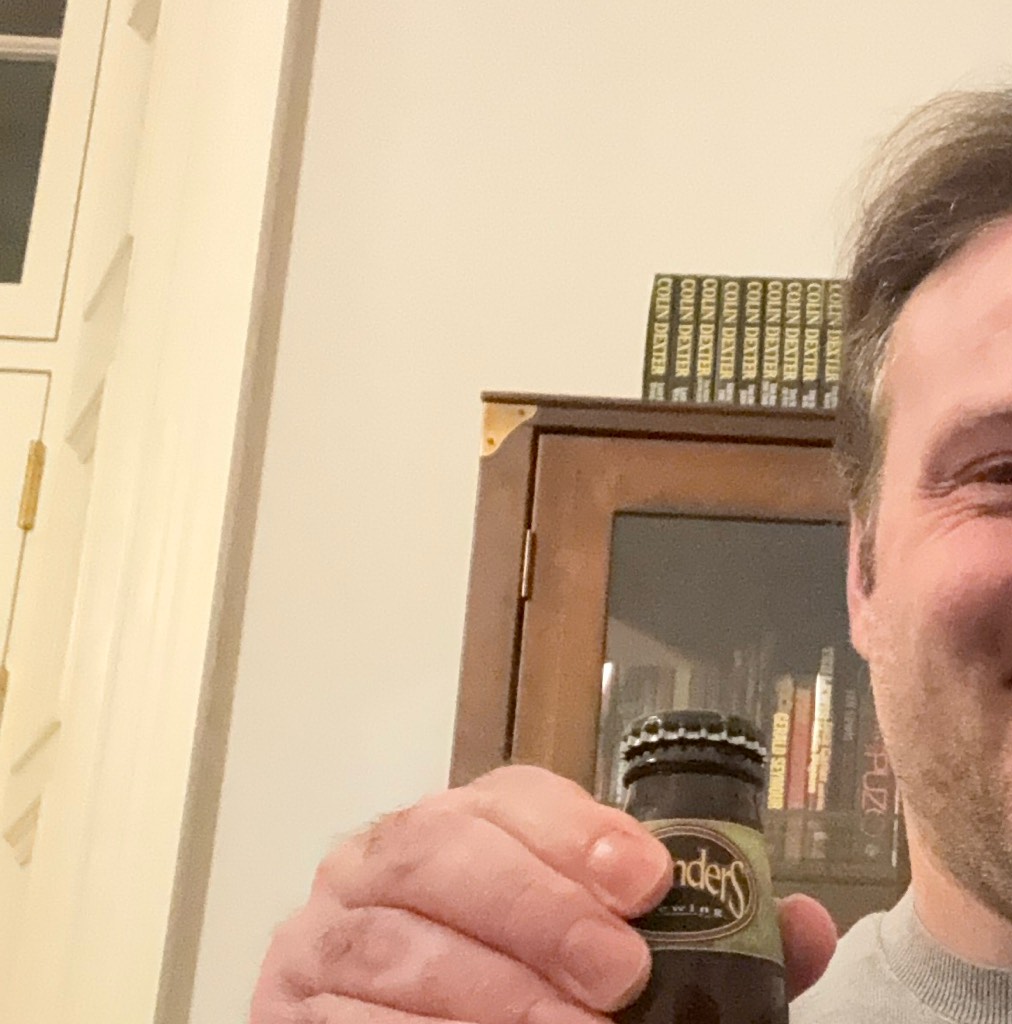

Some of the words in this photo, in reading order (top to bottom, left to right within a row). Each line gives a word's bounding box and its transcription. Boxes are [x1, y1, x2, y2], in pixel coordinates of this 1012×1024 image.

[655, 277, 673, 321] COLIN
[679, 278, 696, 322] COLIN
[701, 278, 718, 321] COLIN
[723, 281, 740, 323] COLIN
[745, 281, 762, 323] COLIN
[766, 280, 783, 324] COLIN
[786, 282, 802, 324] COLIN
[806, 282, 821, 325] COLIN
[651, 322, 669, 375] DEXTER
[675, 323, 694, 377] DEXTER
[697, 322, 715, 379] DEXTER
[719, 326, 737, 380] DEXTER
[741, 325, 760, 380] DEXTER
[762, 325, 781, 379] DEXTER
[782, 327, 801, 381] DEXTER
[802, 328, 820, 381] DEXTER
[673, 848, 744, 919] nders
